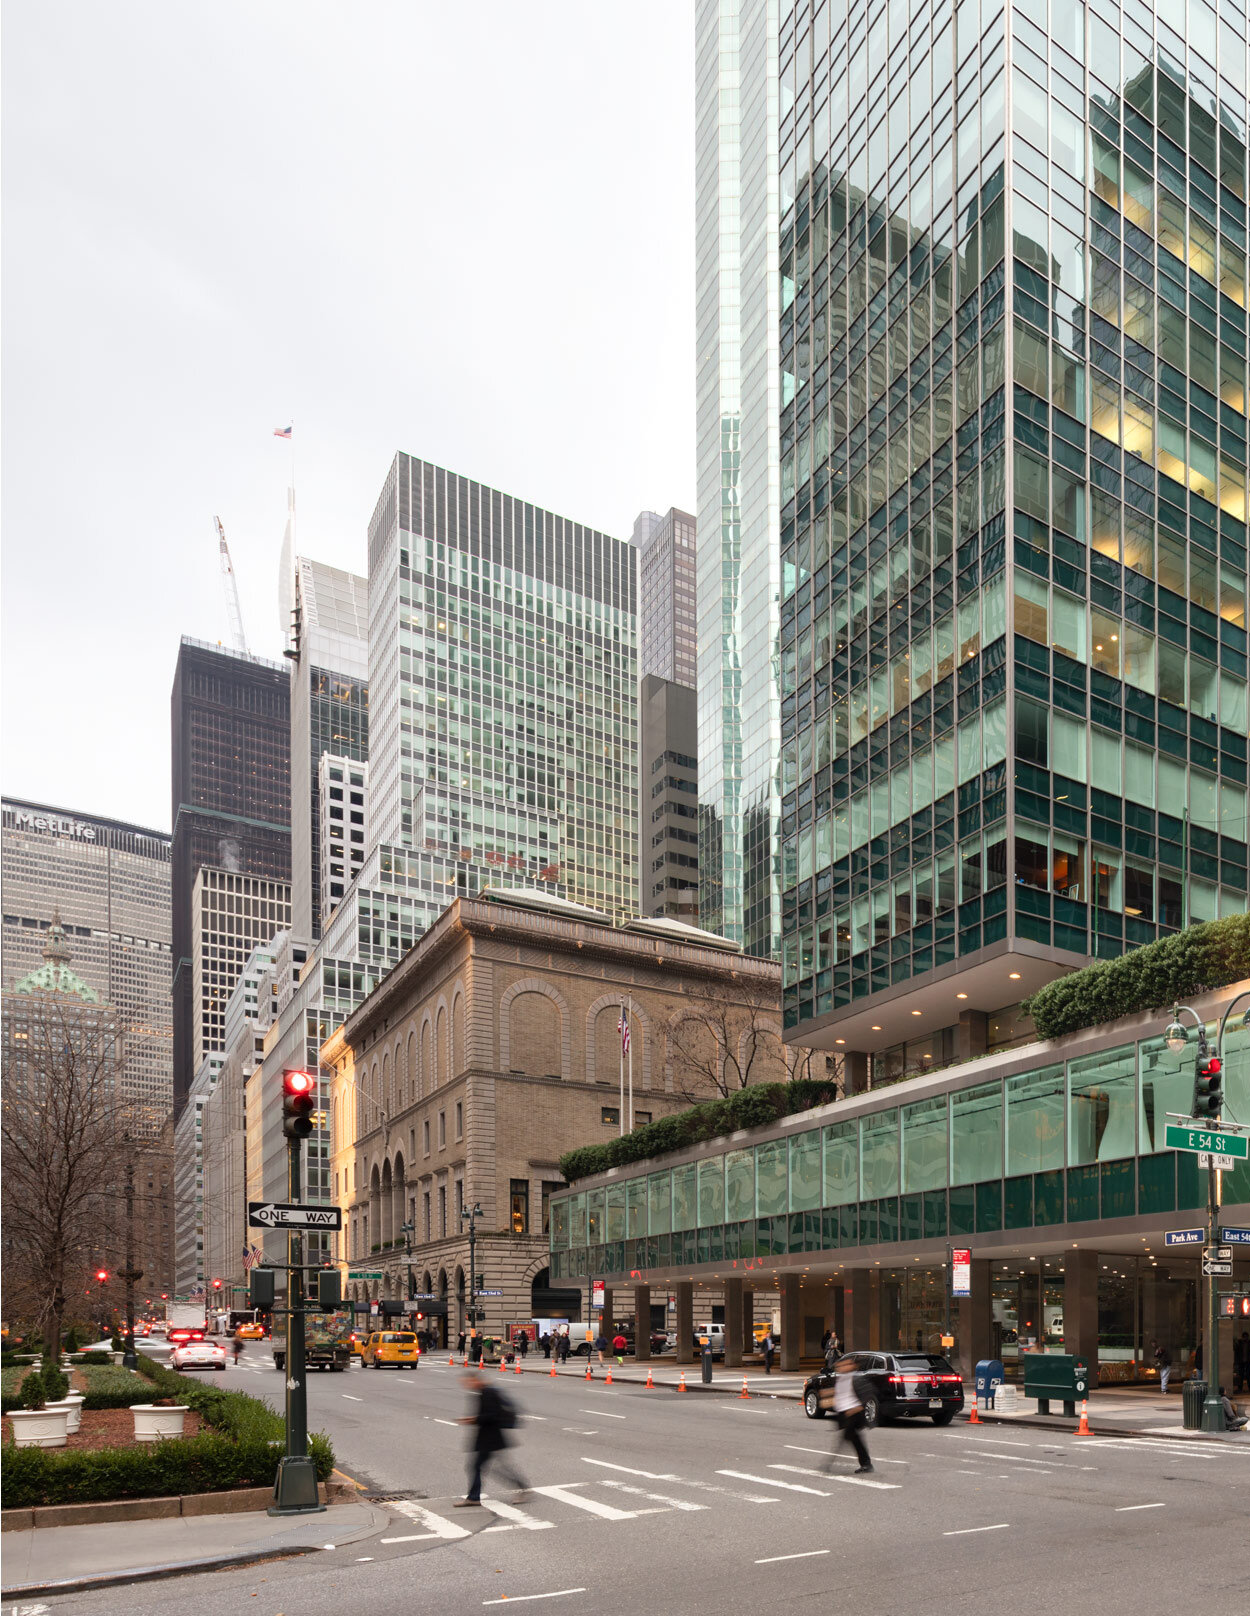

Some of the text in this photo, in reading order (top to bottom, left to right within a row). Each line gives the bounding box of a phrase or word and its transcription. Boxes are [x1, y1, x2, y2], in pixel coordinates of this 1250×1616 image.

[15, 810, 96, 839] MetLife
[1189, 1133, 1226, 1151] E 54 St
[1201, 1154, 1231, 1164] CAS ONLY
[259, 1210, 334, 1223] ONE WAY
[1171, 1232, 1198, 1243] Park Ave
[1225, 1231, 1240, 1240] East
